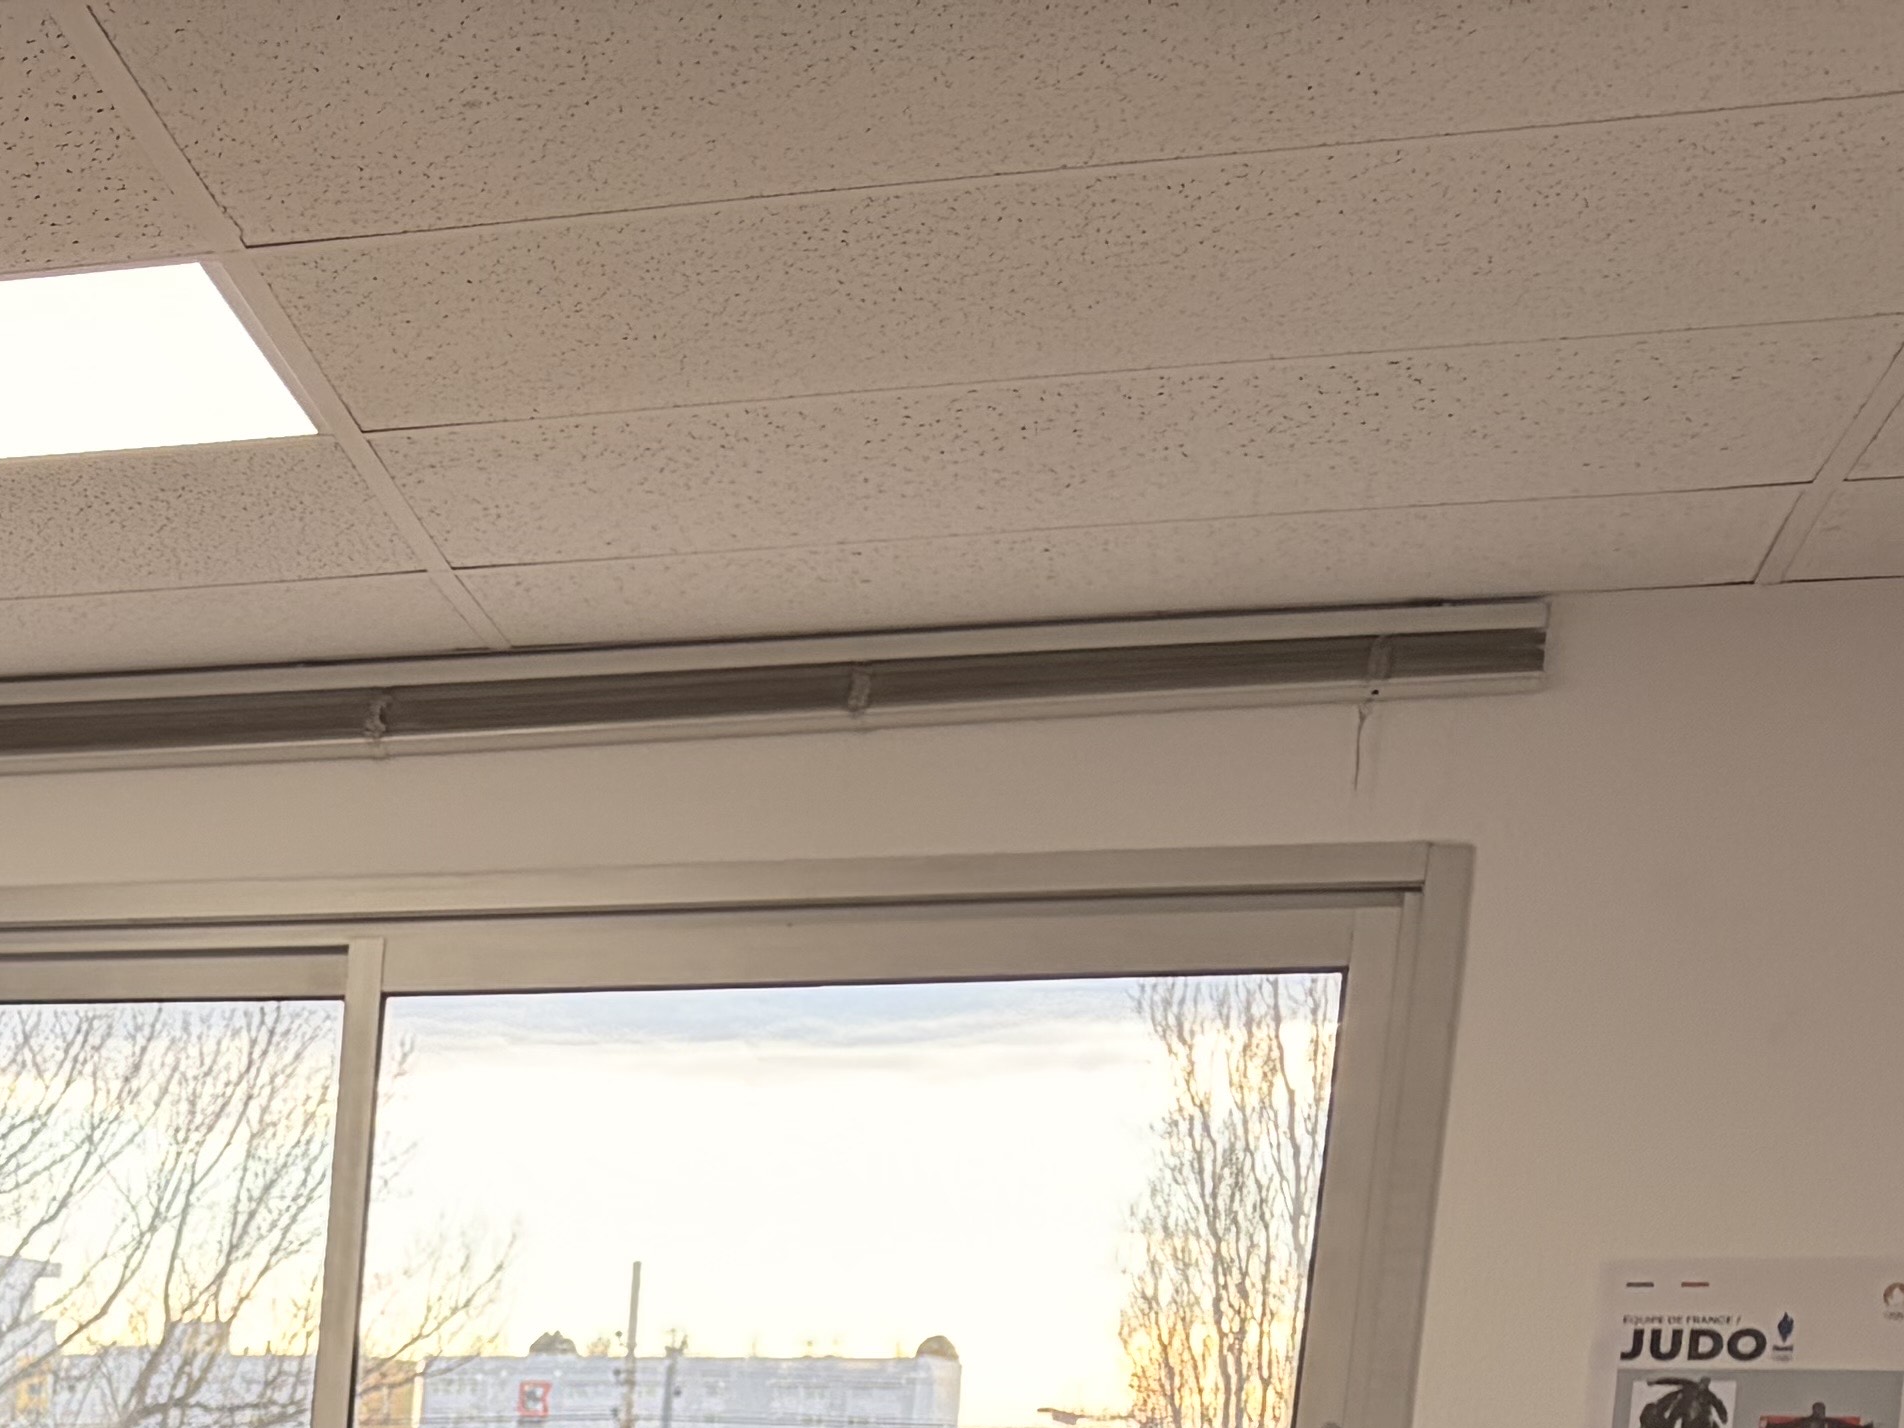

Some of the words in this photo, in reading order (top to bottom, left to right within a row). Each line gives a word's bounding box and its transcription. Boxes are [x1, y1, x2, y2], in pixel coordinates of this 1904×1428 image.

[1667, 1315, 1683, 1325] DE
[1686, 1315, 1732, 1325] FRANCE
[1620, 1328, 1768, 1361] JUDO
